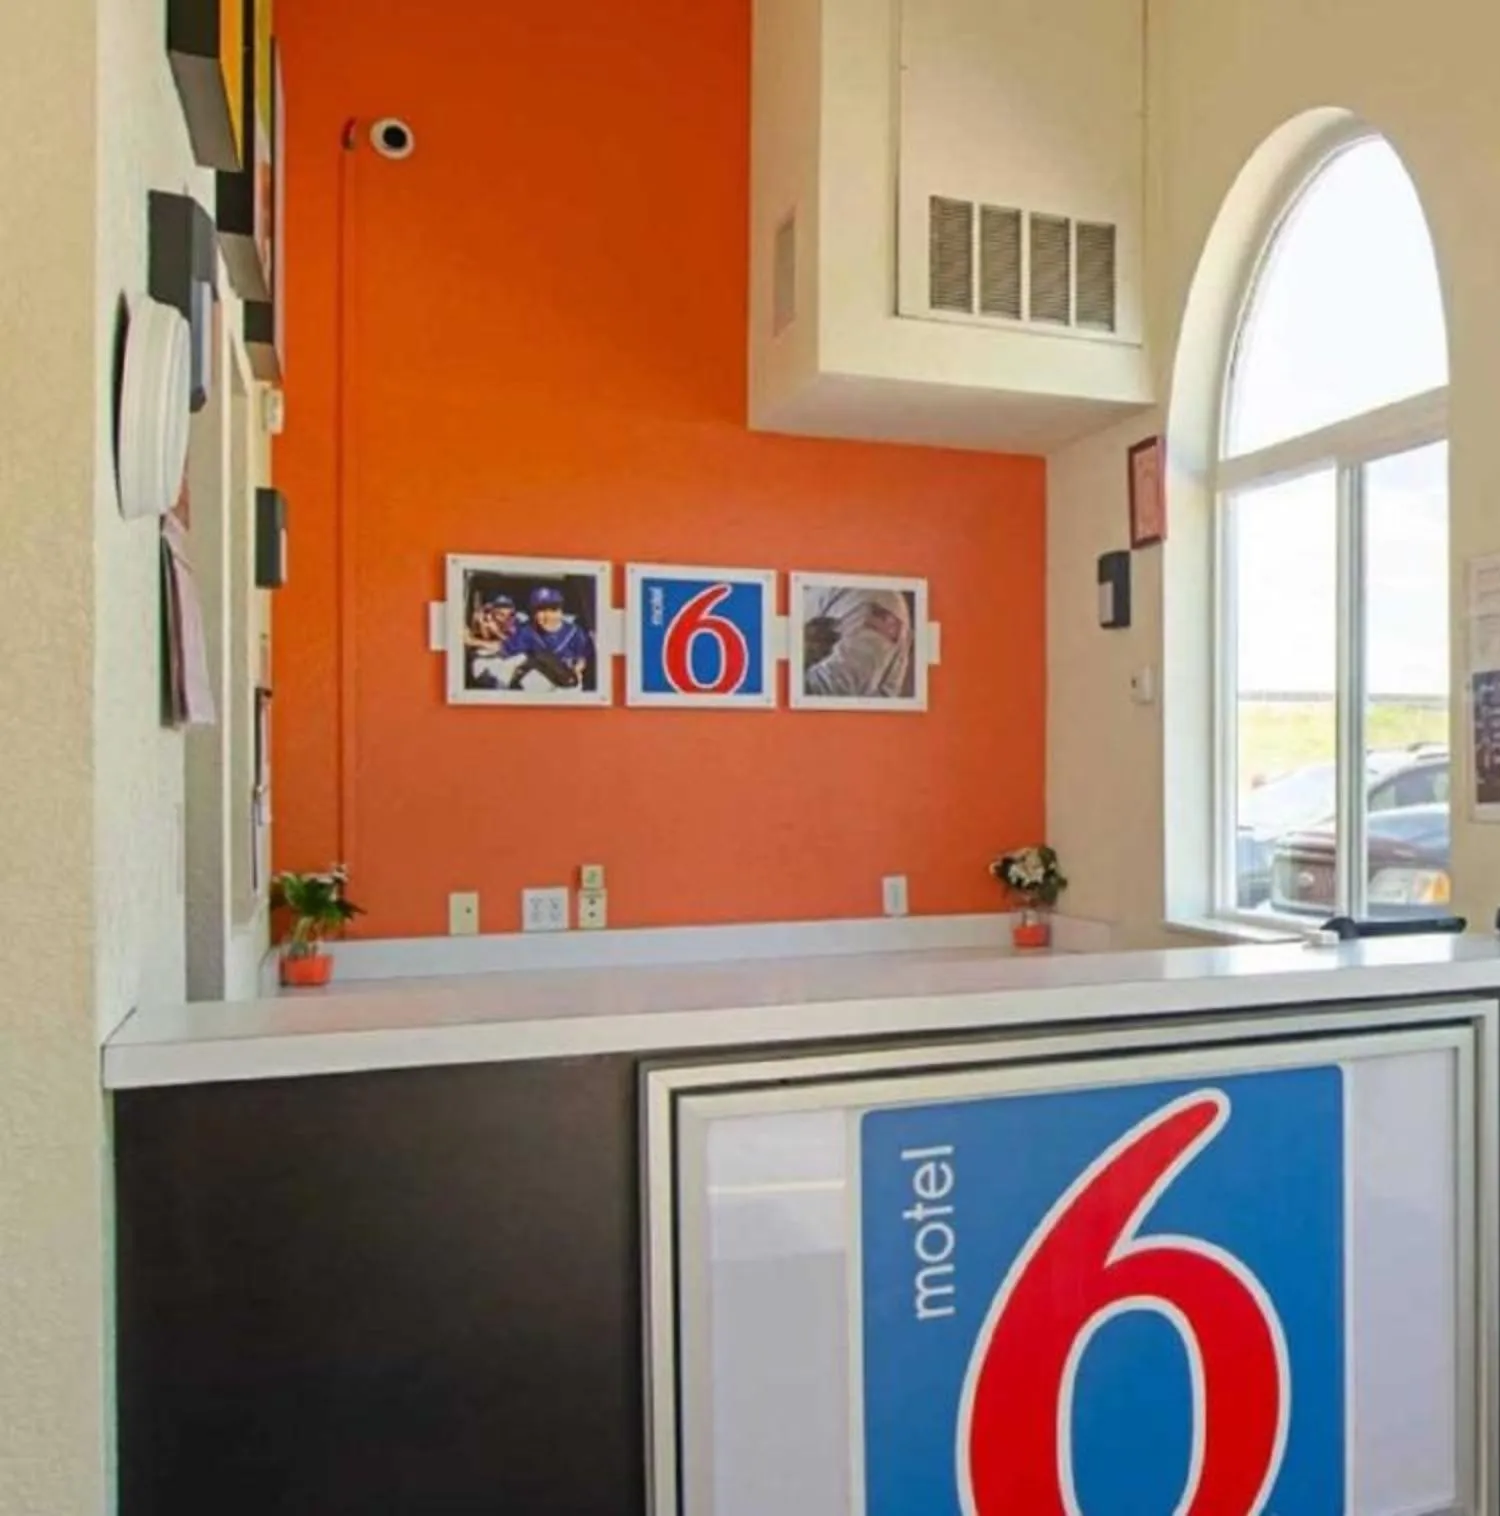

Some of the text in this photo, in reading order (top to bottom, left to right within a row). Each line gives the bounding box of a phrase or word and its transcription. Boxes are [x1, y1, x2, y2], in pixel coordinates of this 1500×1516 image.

[662, 583, 749, 694] 6
[901, 1144, 955, 1320] motel
[955, 1087, 1291, 1516] 6
